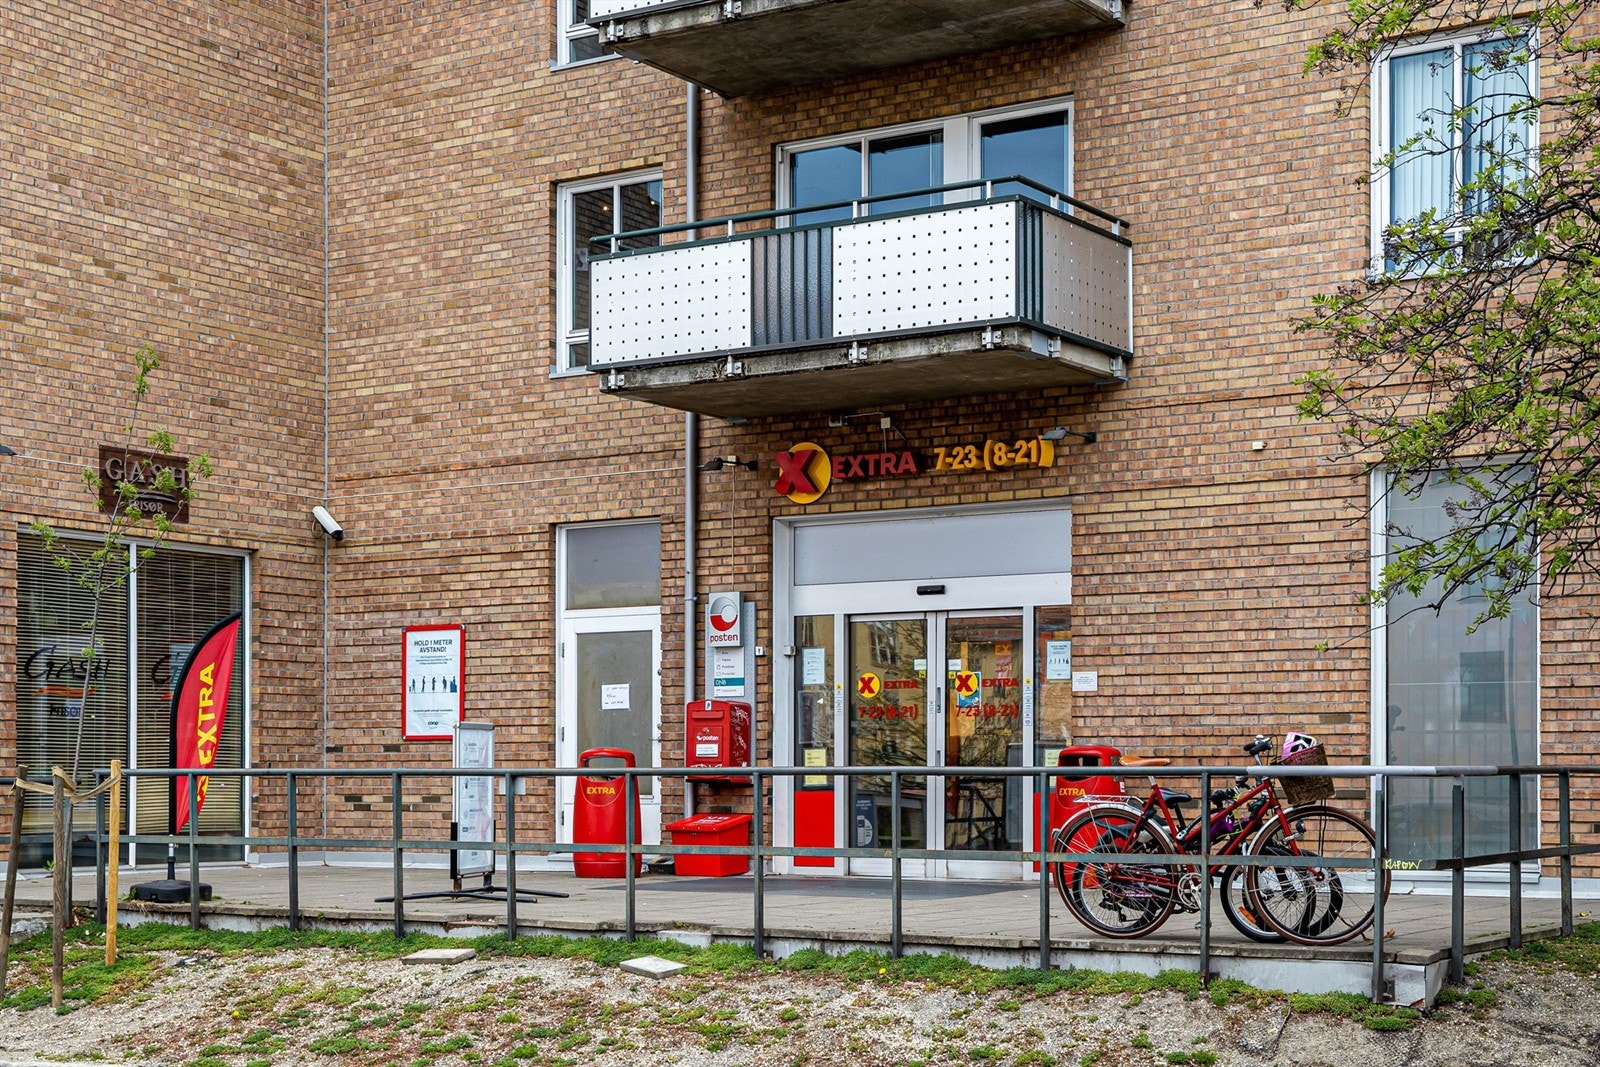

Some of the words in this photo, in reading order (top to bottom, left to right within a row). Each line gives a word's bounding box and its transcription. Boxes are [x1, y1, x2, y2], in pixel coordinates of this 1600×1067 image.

[105, 458, 186, 489] GASH
[775, 449, 819, 495] X
[832, 451, 917, 479] EXTRA
[934, 445, 977, 470] 7-23
[984, 435, 1054, 470] (8-21)
[130, 500, 164, 513] RISØR
[413, 639, 430, 647] HOLD
[433, 638, 453, 646] METER
[710, 633, 739, 643] posten
[25, 645, 111, 680] GASH
[715, 678, 727, 687] DNB
[859, 676, 877, 694] X
[884, 679, 919, 690] EXTRA
[956, 674, 974, 692] X
[982, 678, 1019, 688] EXTRA
[197, 662, 218, 766] EXTRA
[858, 705, 882, 719] 7-23
[885, 703, 919, 720] (8-21)
[956, 705, 980, 717] 7-23
[983, 702, 1019, 719] (8-21)
[586, 786, 616, 795] EXTRA
[1060, 787, 1086, 796] EXTRA
